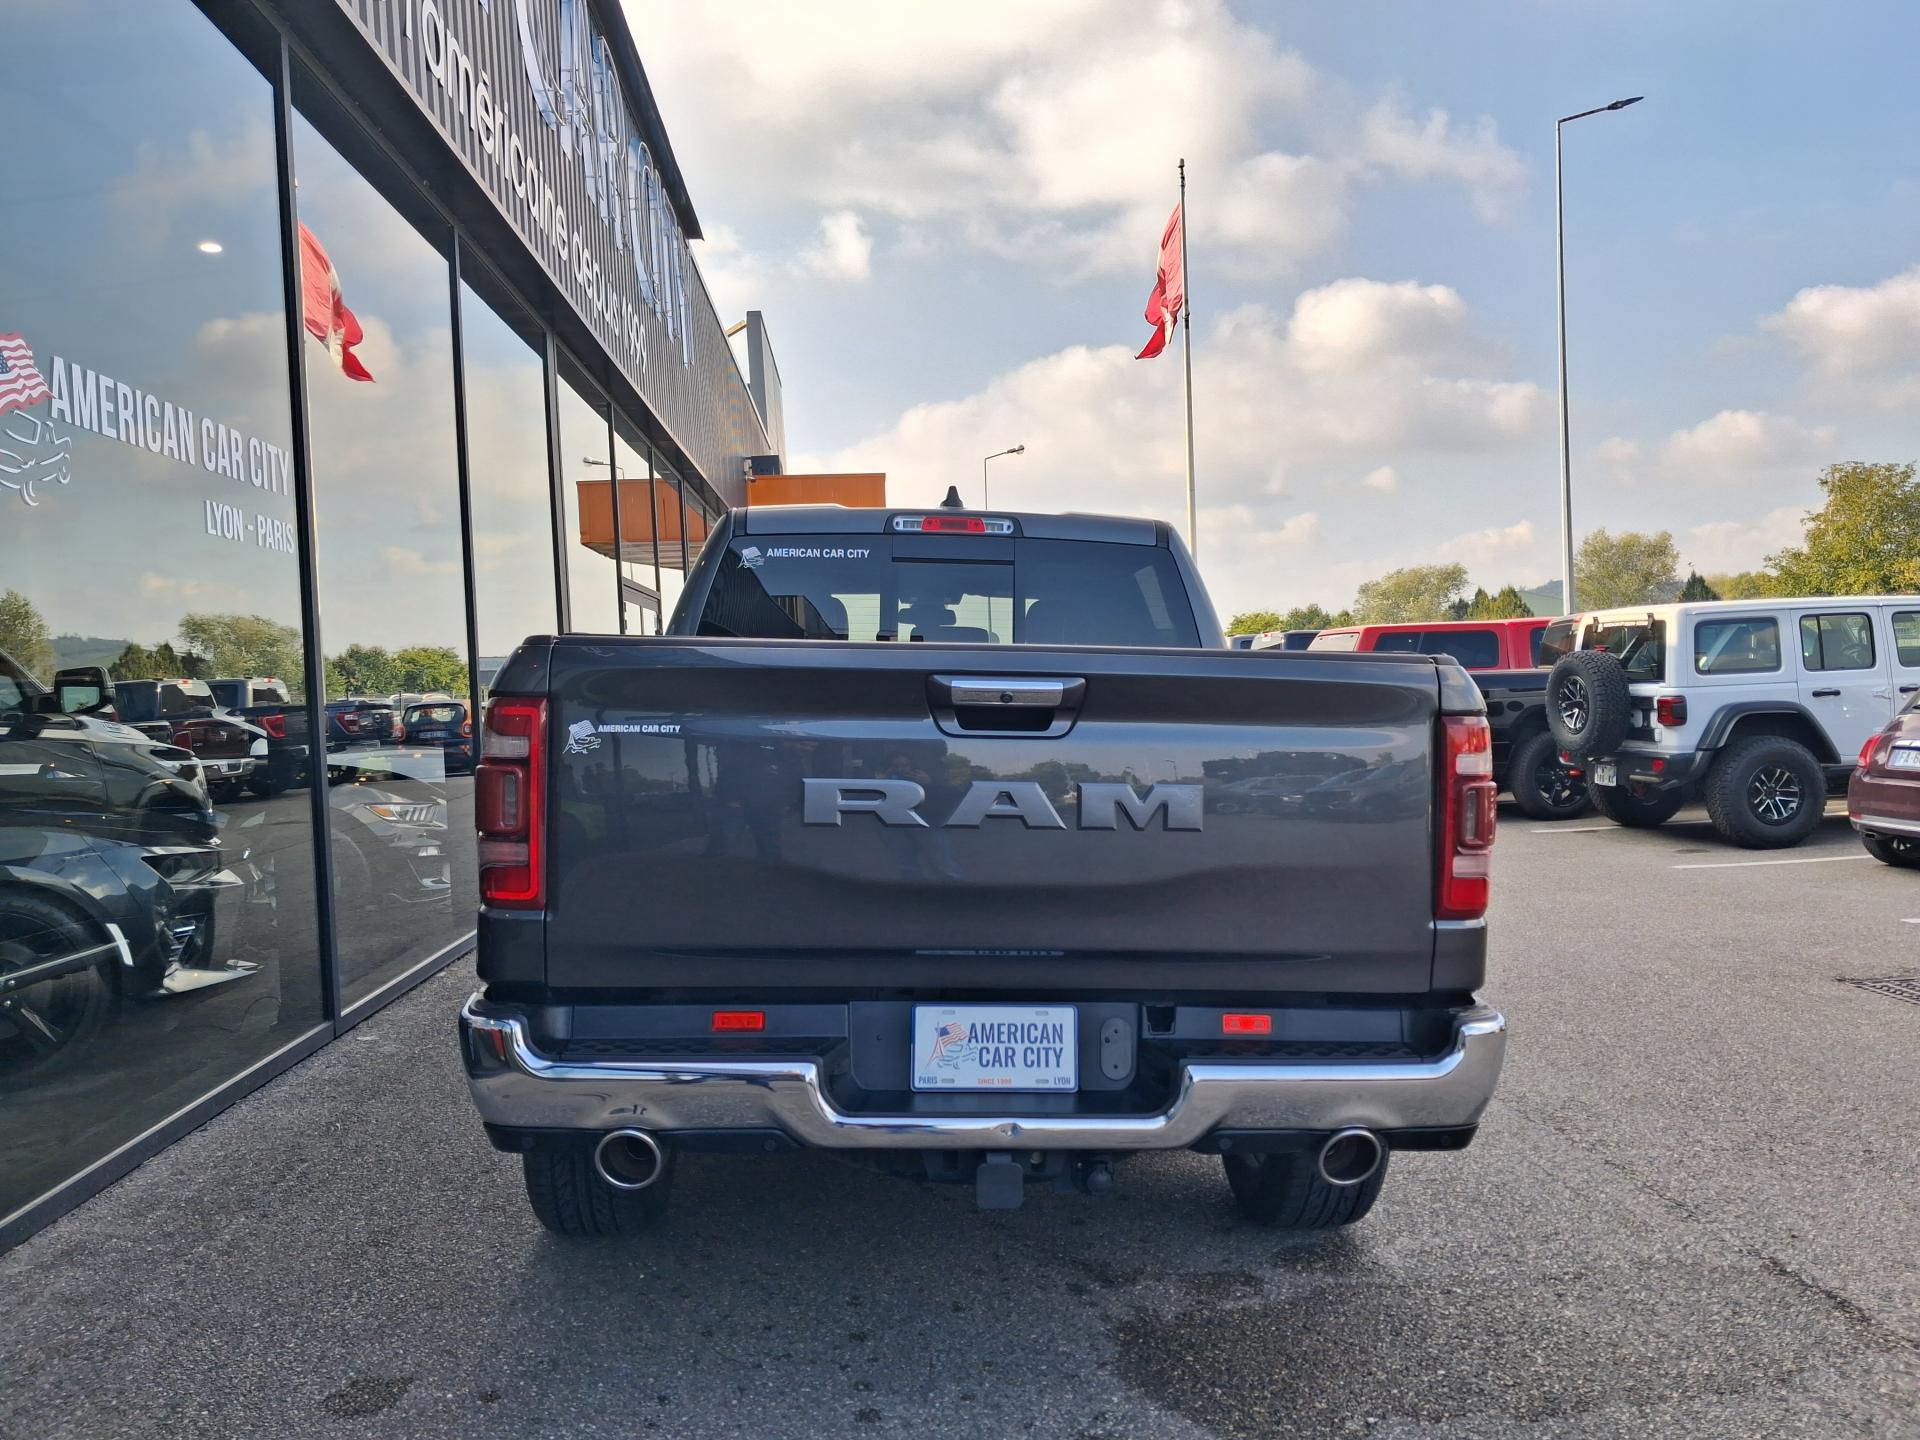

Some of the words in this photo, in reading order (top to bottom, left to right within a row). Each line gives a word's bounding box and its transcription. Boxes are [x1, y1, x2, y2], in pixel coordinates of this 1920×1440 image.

[572, 225, 620, 337] depuis
[621, 294, 648, 374] 1999
[51, 355, 195, 465] AMERICAN
[201, 417, 245, 482] CAR
[249, 436, 289, 496] CITY
[205, 500, 244, 541] LYON
[256, 514, 295, 553] PARIS
[767, 548, 820, 558] AMERICAN
[822, 549, 845, 558] CAR
[847, 549, 870, 559] CITY
[598, 724, 640, 733] AMERICAN
[641, 724, 659, 733] CAR
[660, 724, 680, 733] CITY
[801, 777, 1204, 832] RAM
[967, 1022, 1064, 1045] AMERICAN
[978, 1046, 1016, 1068] CAR
[1023, 1046, 1064, 1068] CITY
[918, 1075, 938, 1085] PARIS
[1054, 1076, 1071, 1086] LYON
